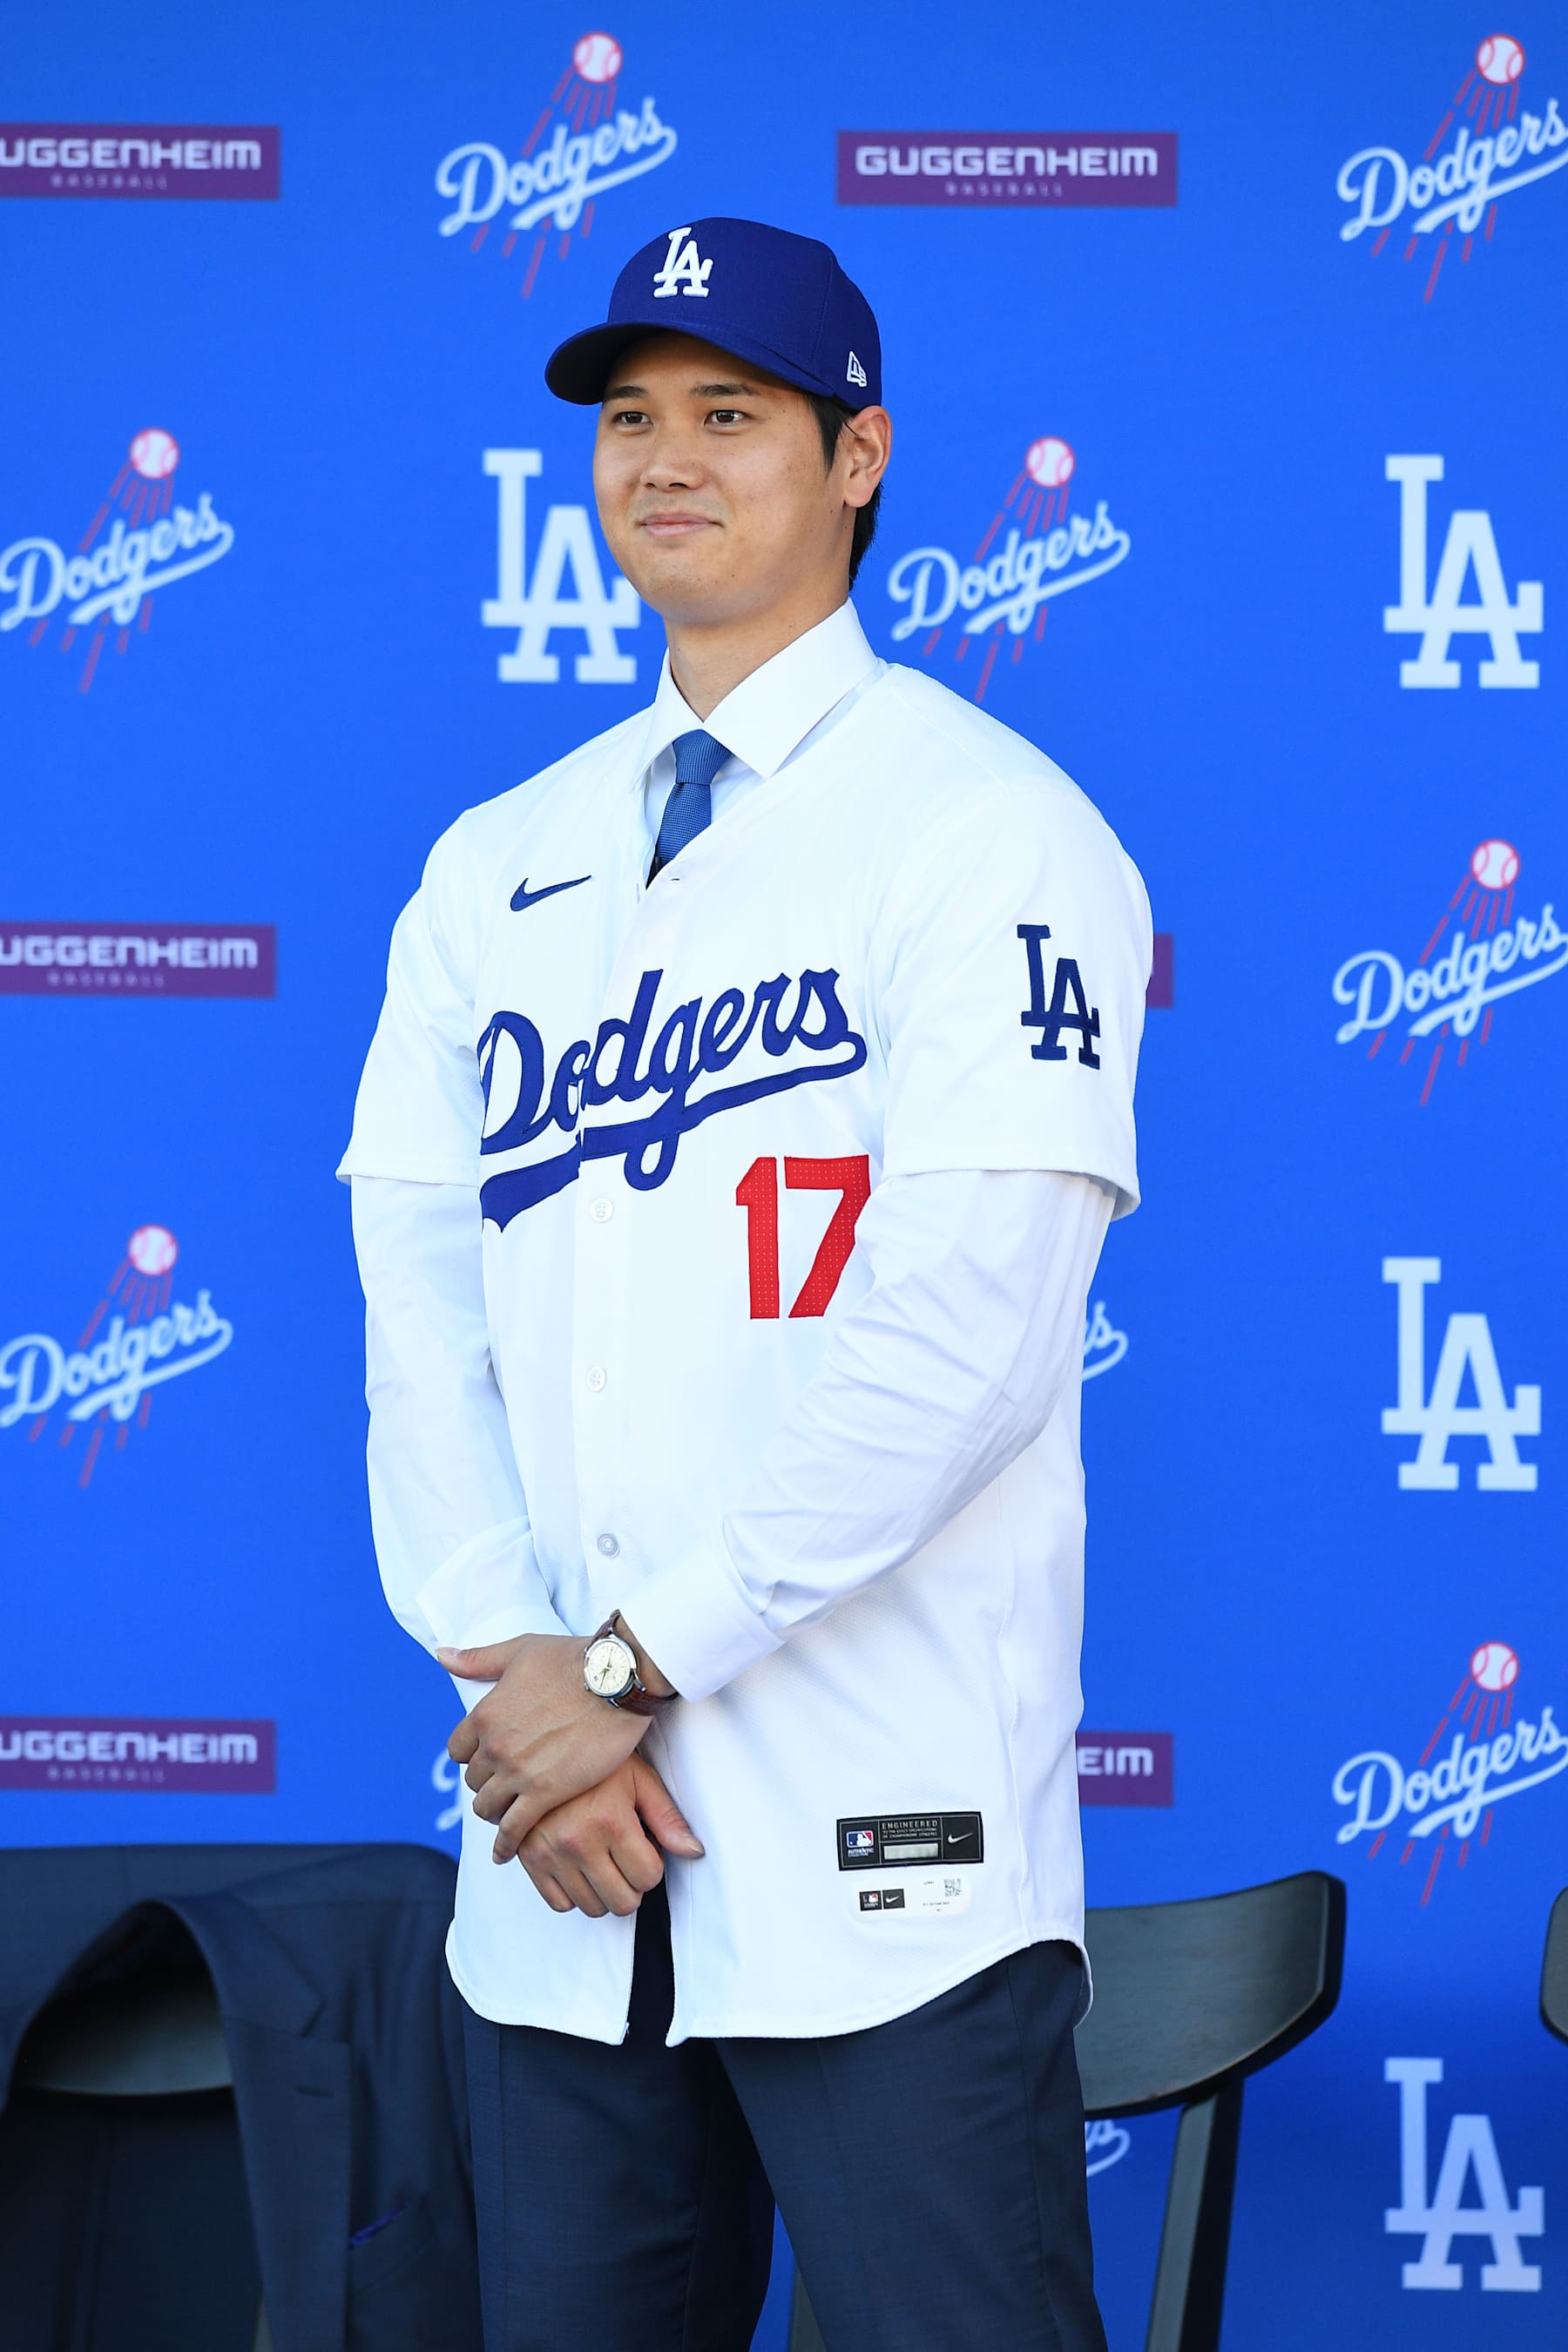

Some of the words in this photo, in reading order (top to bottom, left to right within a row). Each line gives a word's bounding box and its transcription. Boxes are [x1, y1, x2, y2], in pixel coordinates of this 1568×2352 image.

[0, 137, 261, 170] UGGENHEIM
[436, 96, 678, 237] Dodgers
[855, 145, 1159, 176] GUGGENHEIM
[1336, 98, 1568, 242] Dodgers
[653, 226, 713, 298] LA
[0, 492, 234, 632] Dodgers
[481, 449, 640, 683] LA
[887, 501, 1131, 642] Dodgers
[1383, 454, 1544, 689] LA
[0, 935, 259, 969] UGGENHEIM
[1017, 923, 1101, 1071] LA
[1332, 903, 1568, 1044] Dodgers
[476, 968, 868, 1233] Dodgers
[735, 1154, 871, 1320] 17
[0, 1289, 233, 1428] Dodgers
[1382, 1256, 1542, 1492] LA
[0, 1730, 258, 1763] UGGENHEIM
[1332, 1707, 1568, 1844] Dodgers
[882, 1819, 938, 1829] ENGINEERED
[1386, 2058, 1544, 2292] LA
